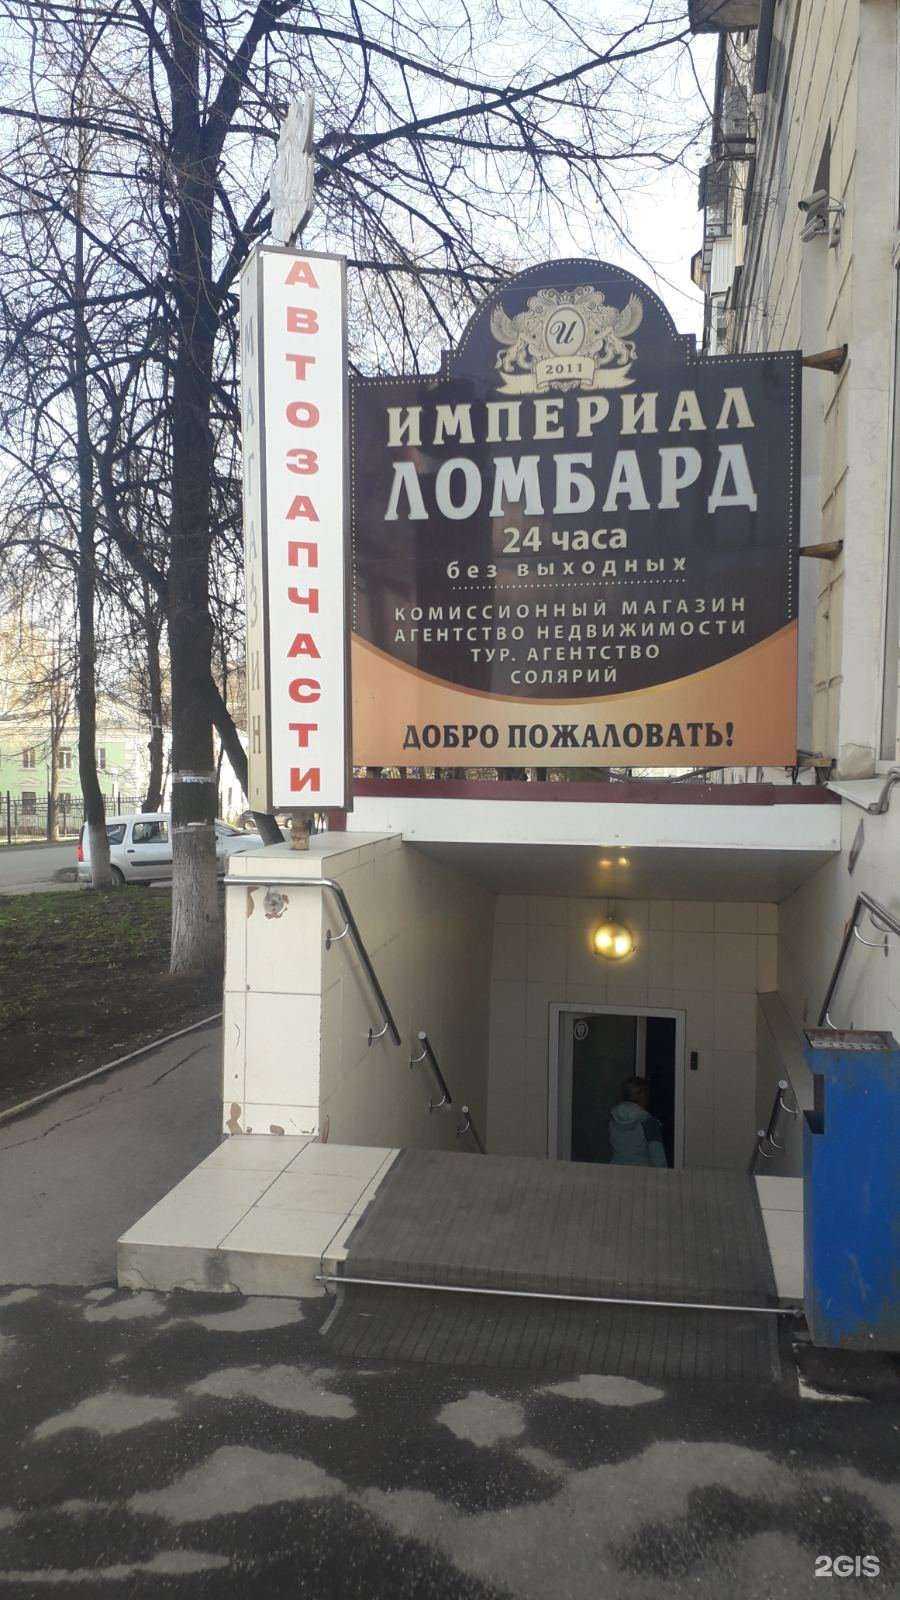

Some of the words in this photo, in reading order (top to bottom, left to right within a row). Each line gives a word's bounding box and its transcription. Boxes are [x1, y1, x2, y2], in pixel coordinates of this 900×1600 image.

[545, 363, 583, 375] 2011
[385, 387, 756, 448] ИМПЕРИАЛ
[384, 443, 758, 521] ЛОМБАРД
[284, 260, 322, 792] АВТОЗАПЧАСТИ
[502, 527, 542, 553] 24
[551, 526, 629, 552] часа
[447, 560, 497, 579] без
[517, 556, 687, 577] выходных
[395, 599, 608, 621] КОМИССИОННЫЙ
[621, 597, 747, 616] МАГАЗИН
[394, 625, 526, 642] АГЕНТСТВО
[536, 619, 747, 642] НЕДВИЖИМОСТИ
[471, 647, 517, 664] ТУР.
[526, 643, 661, 662] АГЕНТСТВО
[510, 668, 618, 684] СОЛЯРИЙ
[402, 723, 500, 750] ДОБРО
[507, 721, 735, 749] ПОЖАЛОВАТЬ!
